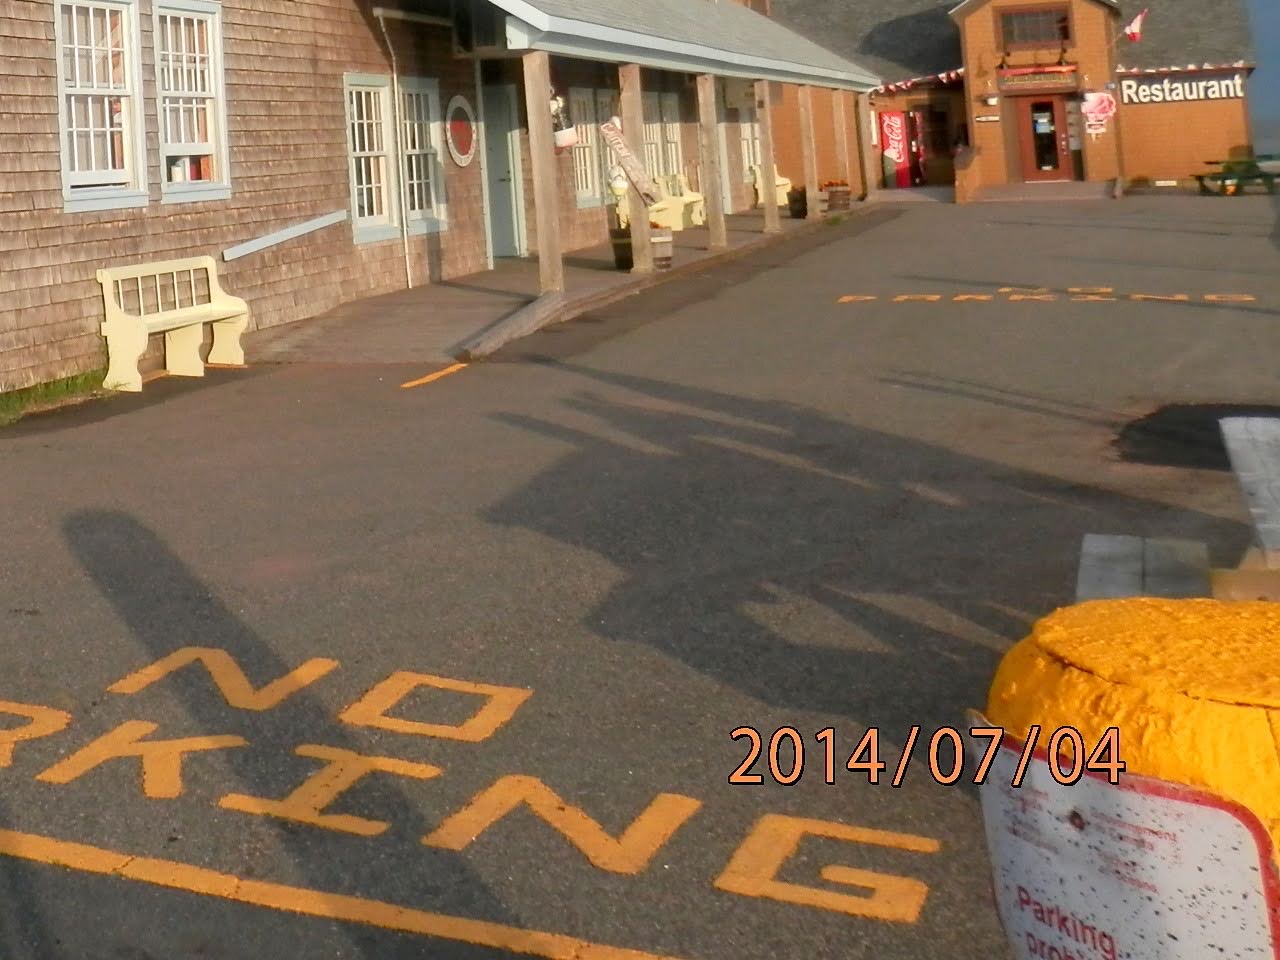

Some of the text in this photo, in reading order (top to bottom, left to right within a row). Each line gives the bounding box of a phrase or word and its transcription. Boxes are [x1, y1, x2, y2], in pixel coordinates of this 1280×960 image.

[1120, 74, 1245, 103] Restaurant
[107, 646, 534, 742] NO
[1016, 885, 1117, 960] Parking
